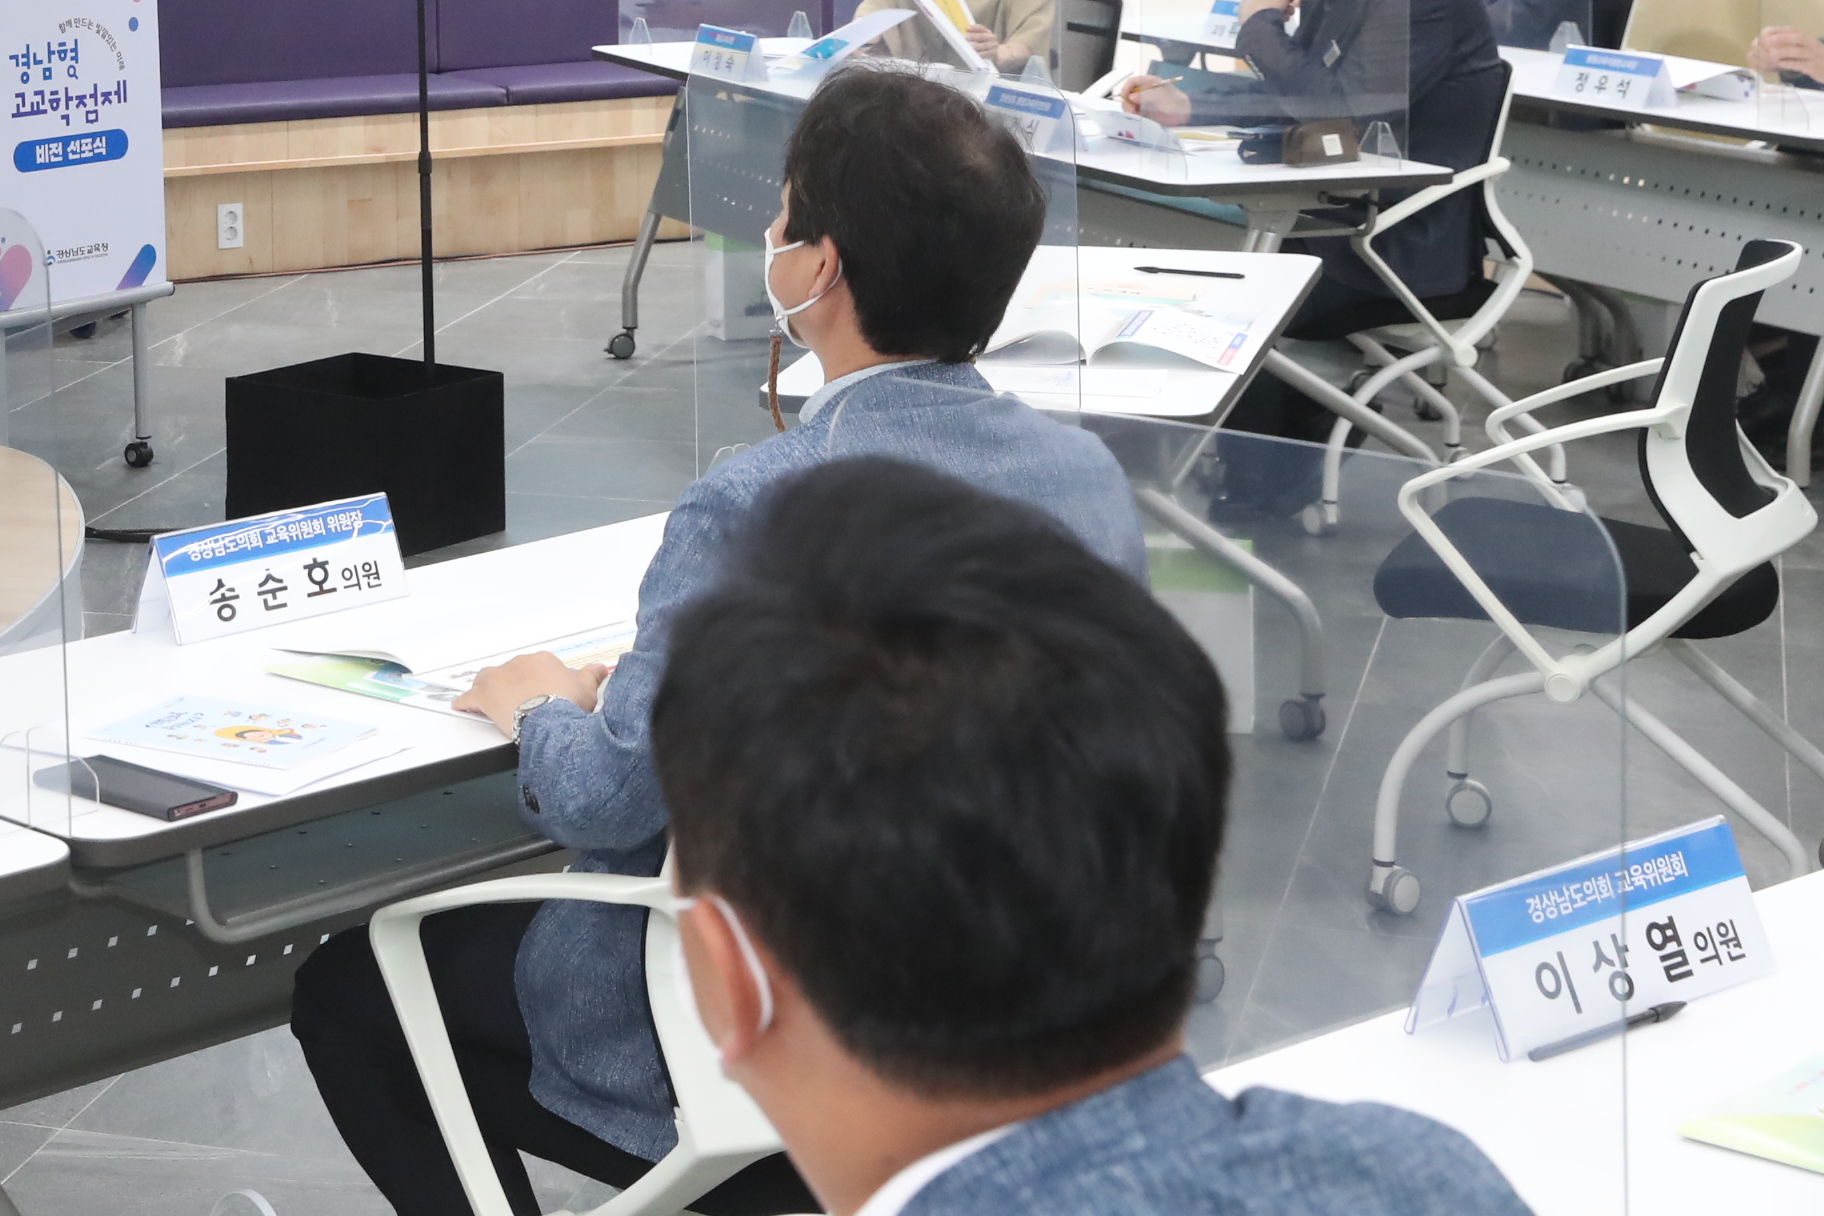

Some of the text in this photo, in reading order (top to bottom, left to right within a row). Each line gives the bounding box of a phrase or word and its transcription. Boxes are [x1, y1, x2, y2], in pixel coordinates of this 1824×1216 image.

[9, 38, 79, 85] 경남형
[73, 17, 94, 31] 만드는
[116, 51, 126, 71] 미래
[11, 79, 127, 126] 고교학점제
[35, 136, 107, 164] 비전 선포식
[56, 243, 109, 259] 경상남도교육청
[265, 517, 326, 545] 교육위원회
[326, 509, 364, 534] 위원장
[1525, 850, 1689, 923] 경상남도의회 교육위원회
